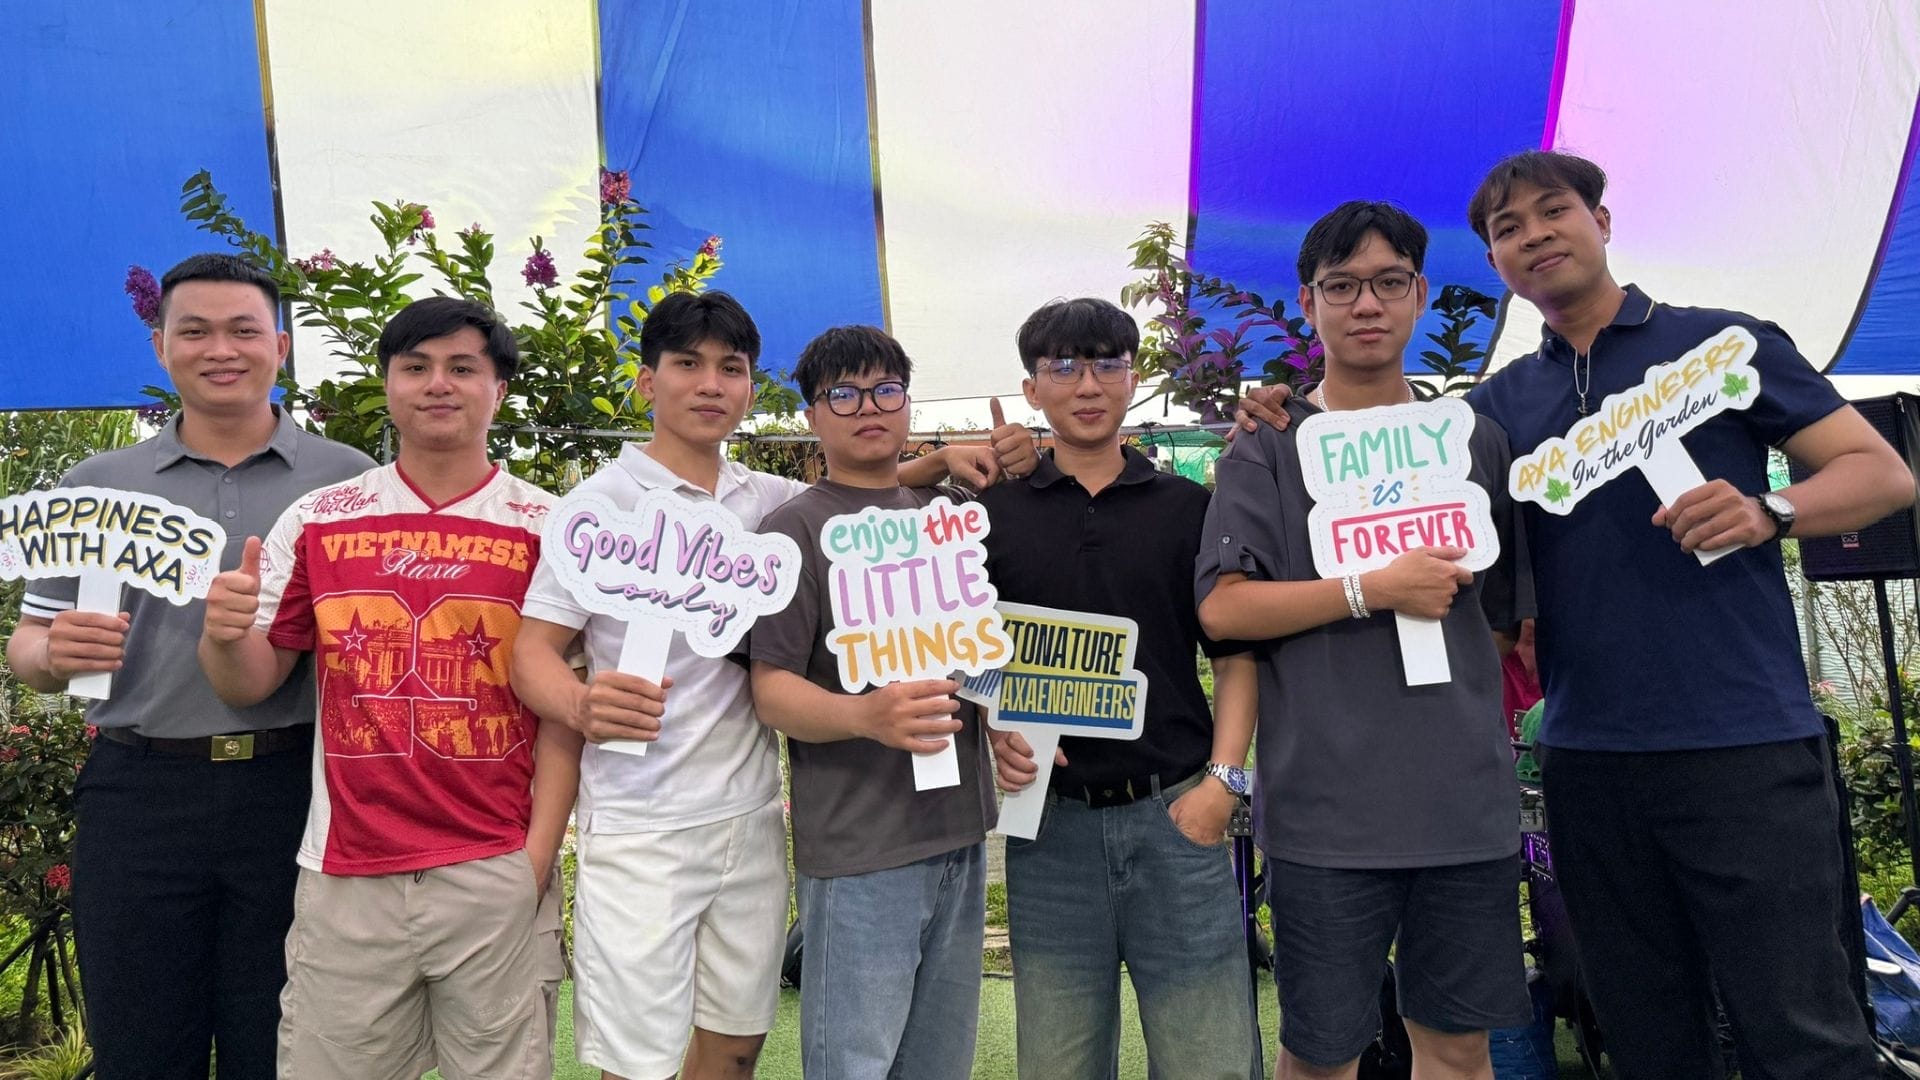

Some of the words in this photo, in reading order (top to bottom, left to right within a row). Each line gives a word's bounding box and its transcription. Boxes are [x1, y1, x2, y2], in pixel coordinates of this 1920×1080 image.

[1517, 446, 1567, 492] AXA
[1575, 335, 1745, 455] ENGINEERS
[1572, 459, 1601, 490] In
[1600, 440, 1638, 470] the
[1637, 390, 1718, 460] Garden
[1319, 418, 1451, 484] FAMILY
[1373, 479, 1403, 506] is
[0, 496, 216, 557] HAPPINESS
[321, 530, 530, 573] VIETNAMESE
[564, 509, 666, 574] Good
[674, 521, 782, 596] Vibes
[829, 514, 919, 564] enjoy
[923, 505, 982, 546] the
[1331, 506, 1475, 564] FOREVER
[19, 532, 106, 569] WITH
[114, 540, 187, 595] AXA
[838, 549, 990, 627] LITTLE
[594, 582, 738, 637] only
[835, 617, 1005, 684] THINGS
[1000, 675, 1137, 721] AXAENGINEERS
